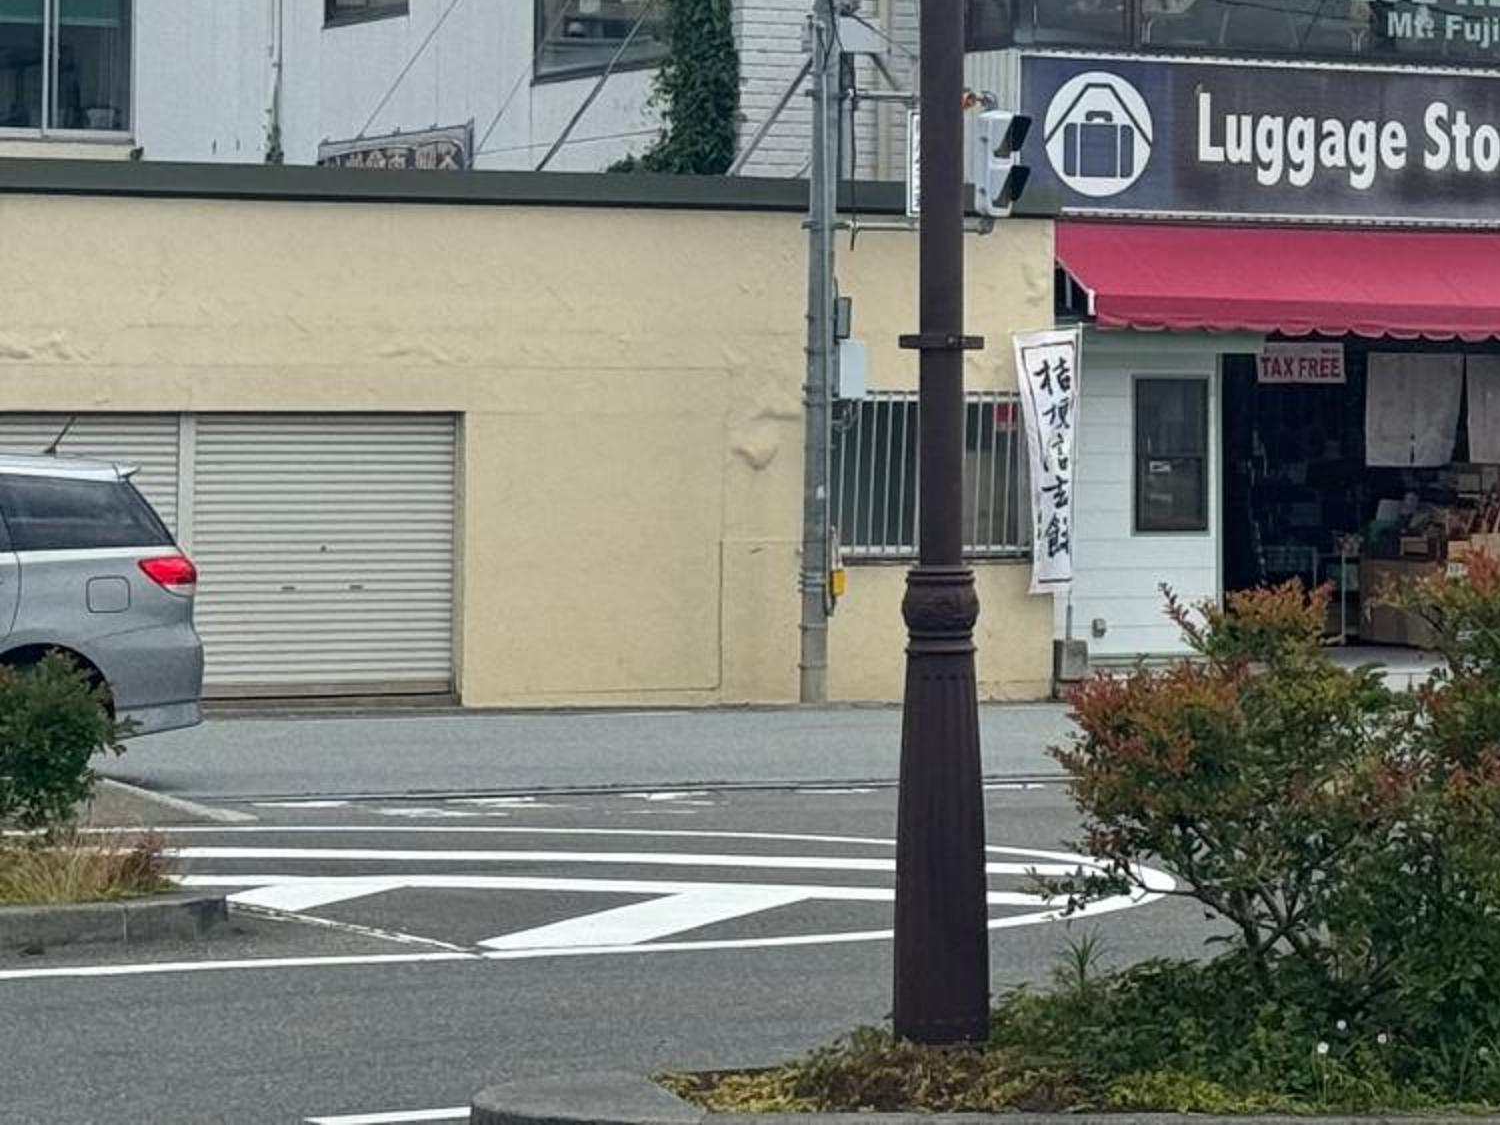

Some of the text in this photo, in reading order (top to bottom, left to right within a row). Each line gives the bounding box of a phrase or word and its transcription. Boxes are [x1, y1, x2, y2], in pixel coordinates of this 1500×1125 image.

[1445, 14, 1500, 48] Fuji
[1198, 92, 1407, 189] Luggage
[1261, 355, 1341, 379] TAX FREE
